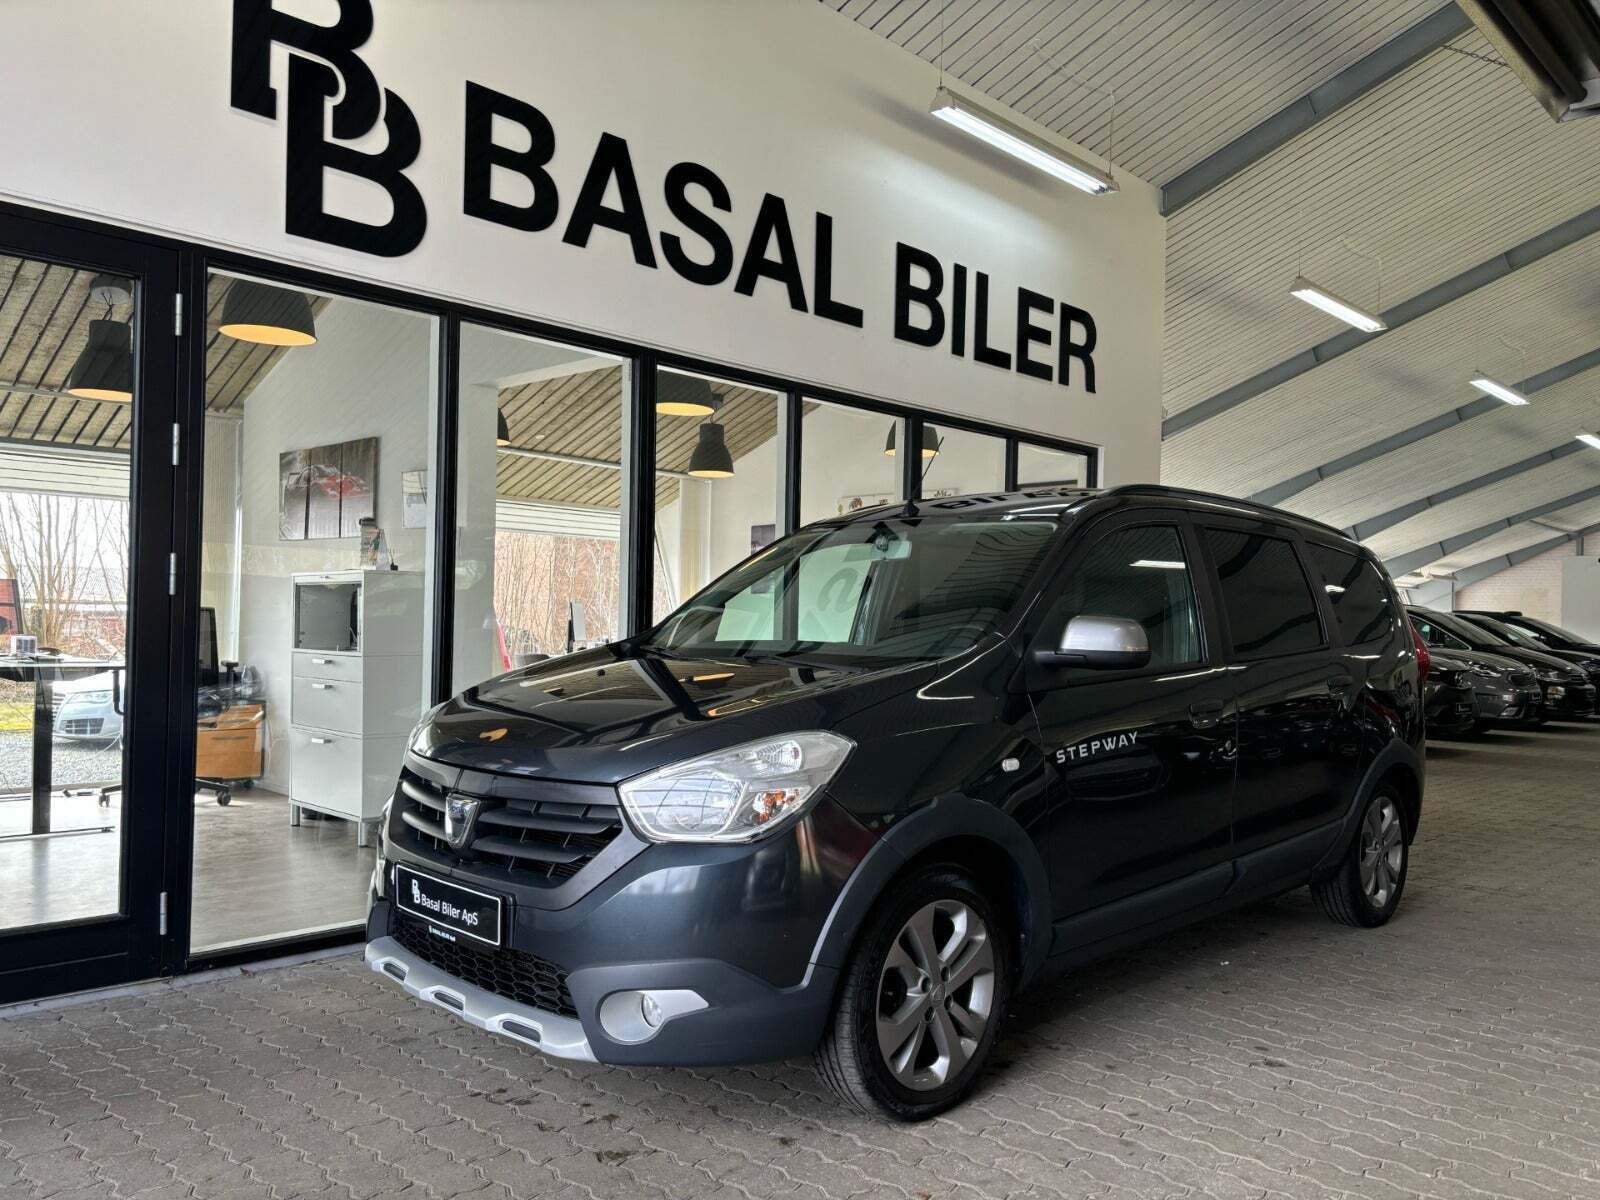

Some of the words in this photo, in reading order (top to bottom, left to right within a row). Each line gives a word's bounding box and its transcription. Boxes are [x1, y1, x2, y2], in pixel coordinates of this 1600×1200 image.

[463, 80, 864, 329] BASAL
[894, 241, 1097, 394] BILER
[1056, 731, 1138, 764] STEPWAY
[421, 893, 441, 913] Basal
[441, 901, 461, 919] Biler
[461, 908, 479, 926] ApS
